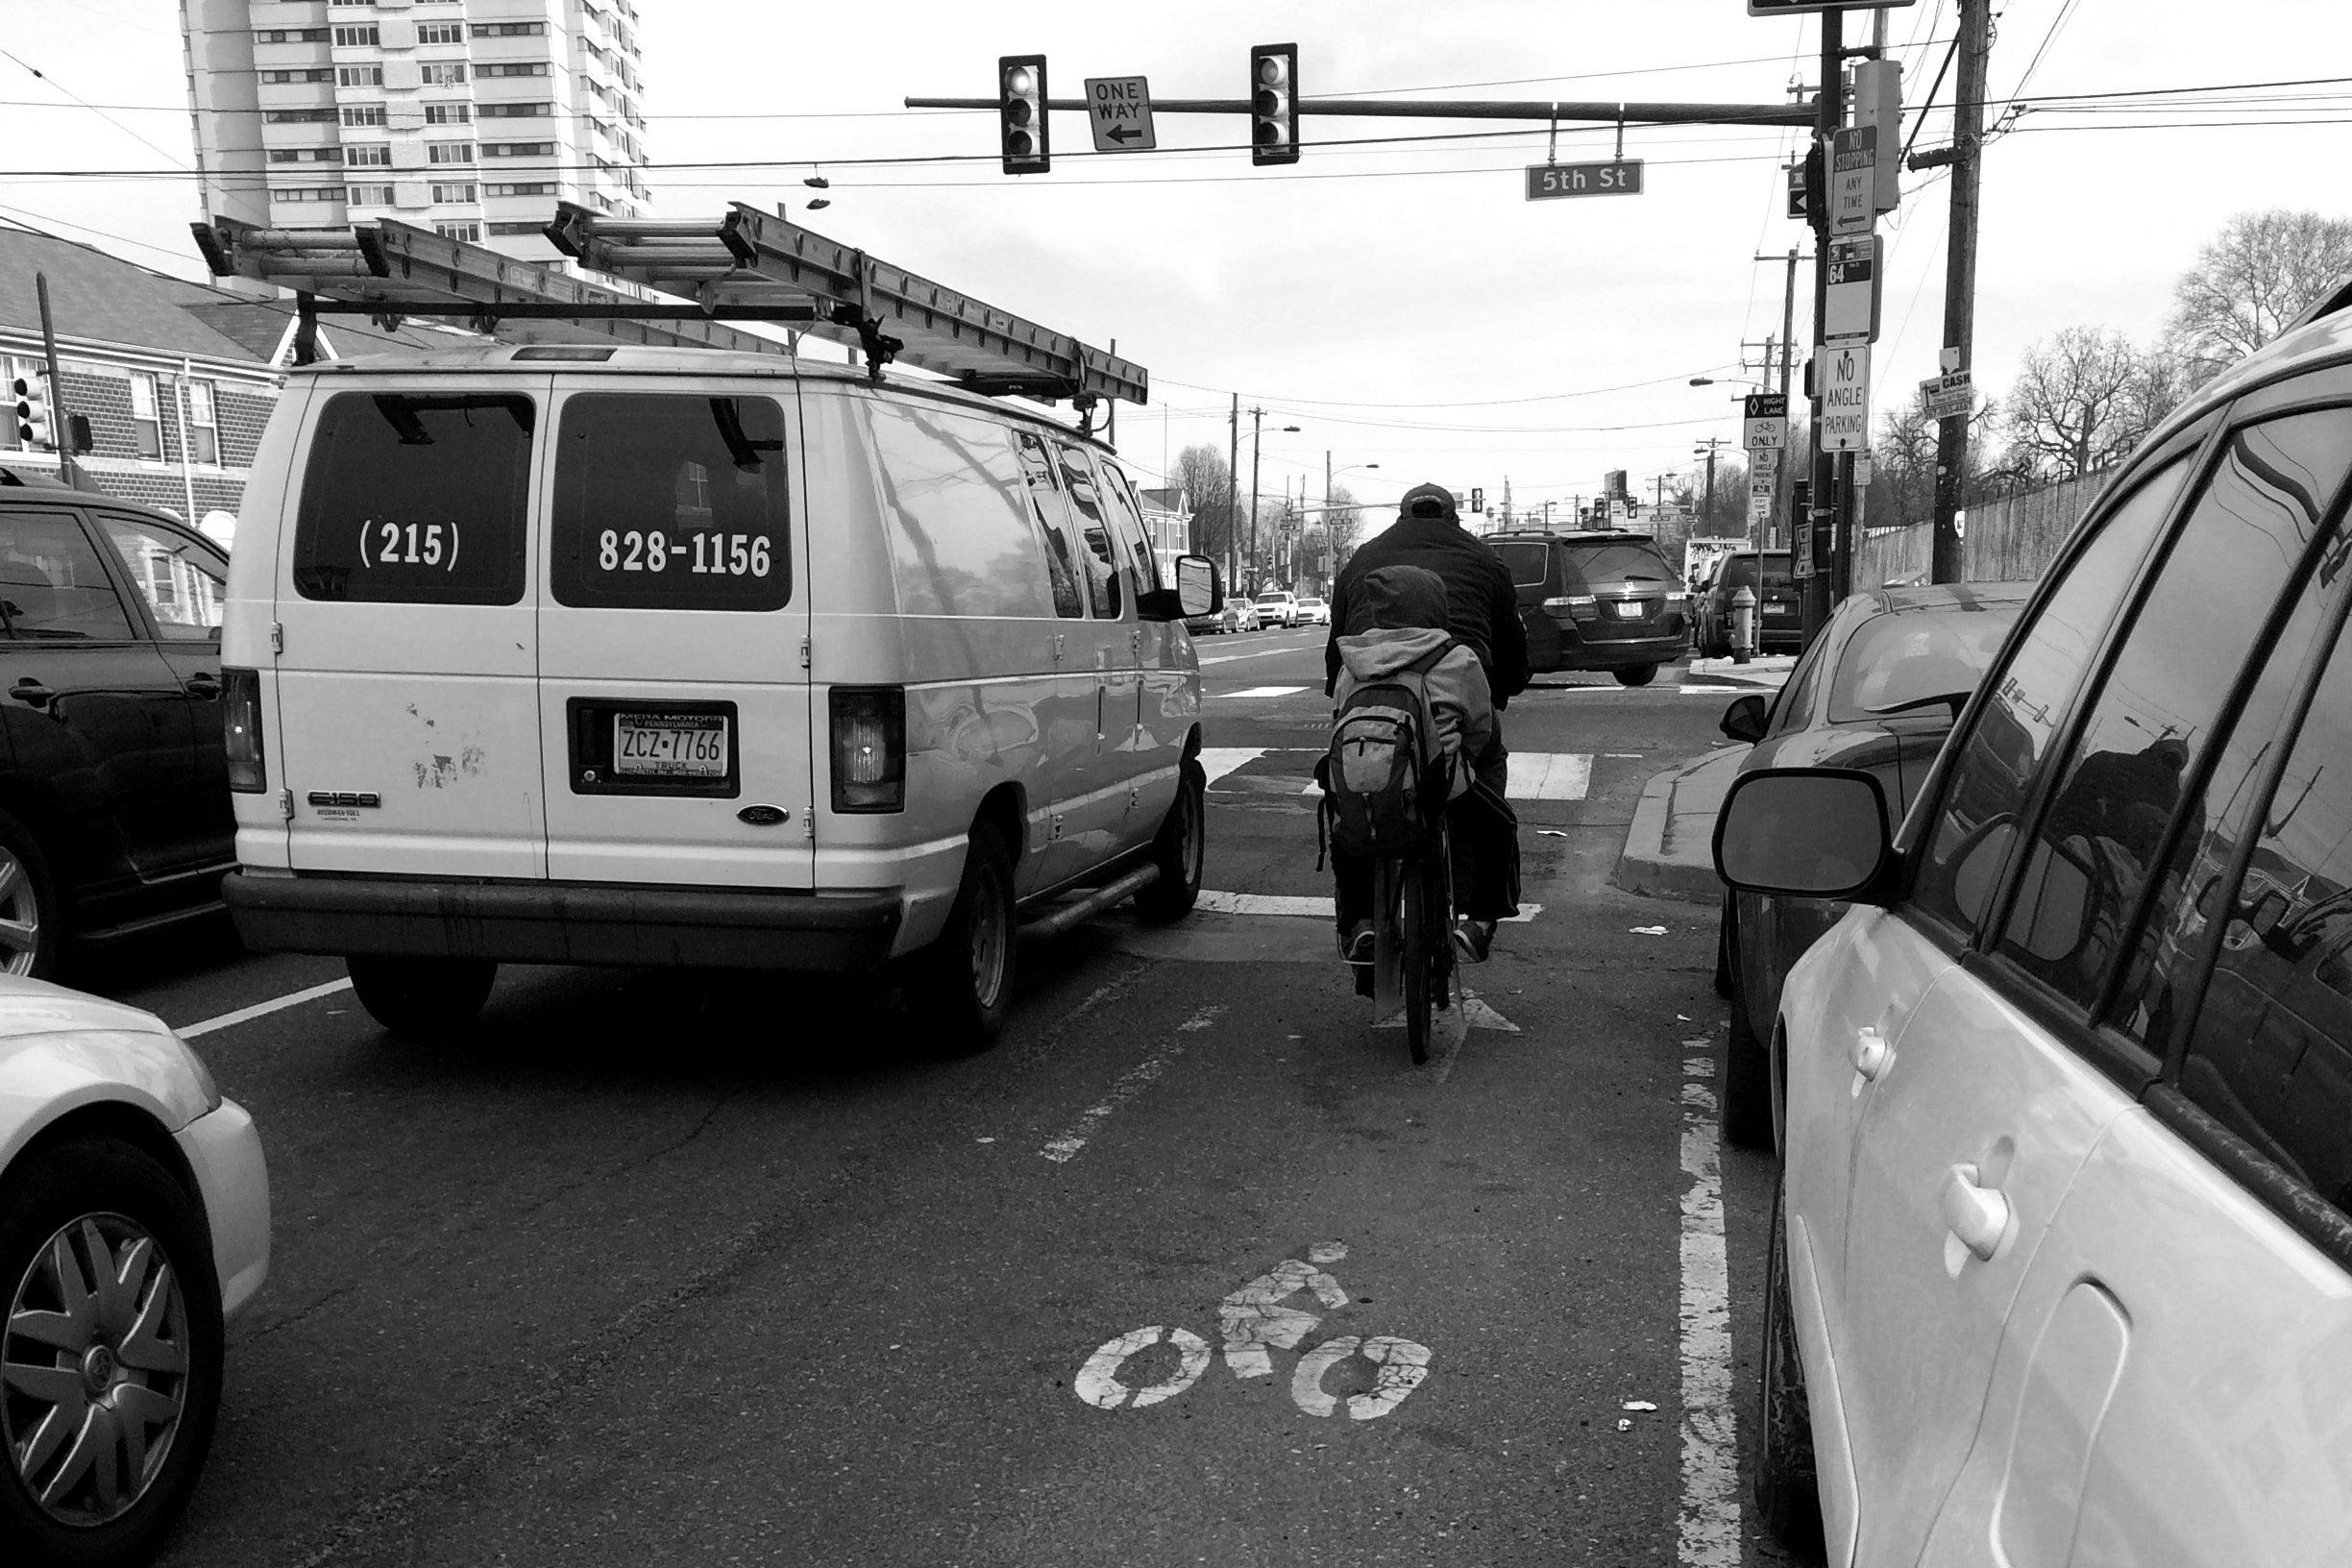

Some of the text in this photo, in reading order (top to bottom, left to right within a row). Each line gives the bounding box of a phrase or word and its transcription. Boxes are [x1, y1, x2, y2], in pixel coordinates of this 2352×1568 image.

[1096, 83, 1139, 101] ONE
[1097, 102, 1139, 120] WAY
[1849, 129, 1863, 151] NO
[1836, 149, 1874, 172] STOPPING
[1543, 167, 1627, 191] 5th St
[1846, 176, 1863, 191] ANY
[1844, 194, 1864, 209] TIME
[1829, 263, 1845, 284] 64
[1836, 356, 1855, 382] NO
[1942, 373, 1972, 389] CASH
[1826, 386, 1863, 407] ANGLE
[1825, 414, 1862, 434] PARKING
[1752, 435, 1777, 448] ONLY
[360, 520, 459, 572] (215)
[600, 529, 772, 577] 828-1156
[655, 761, 688, 771] TRUCK
